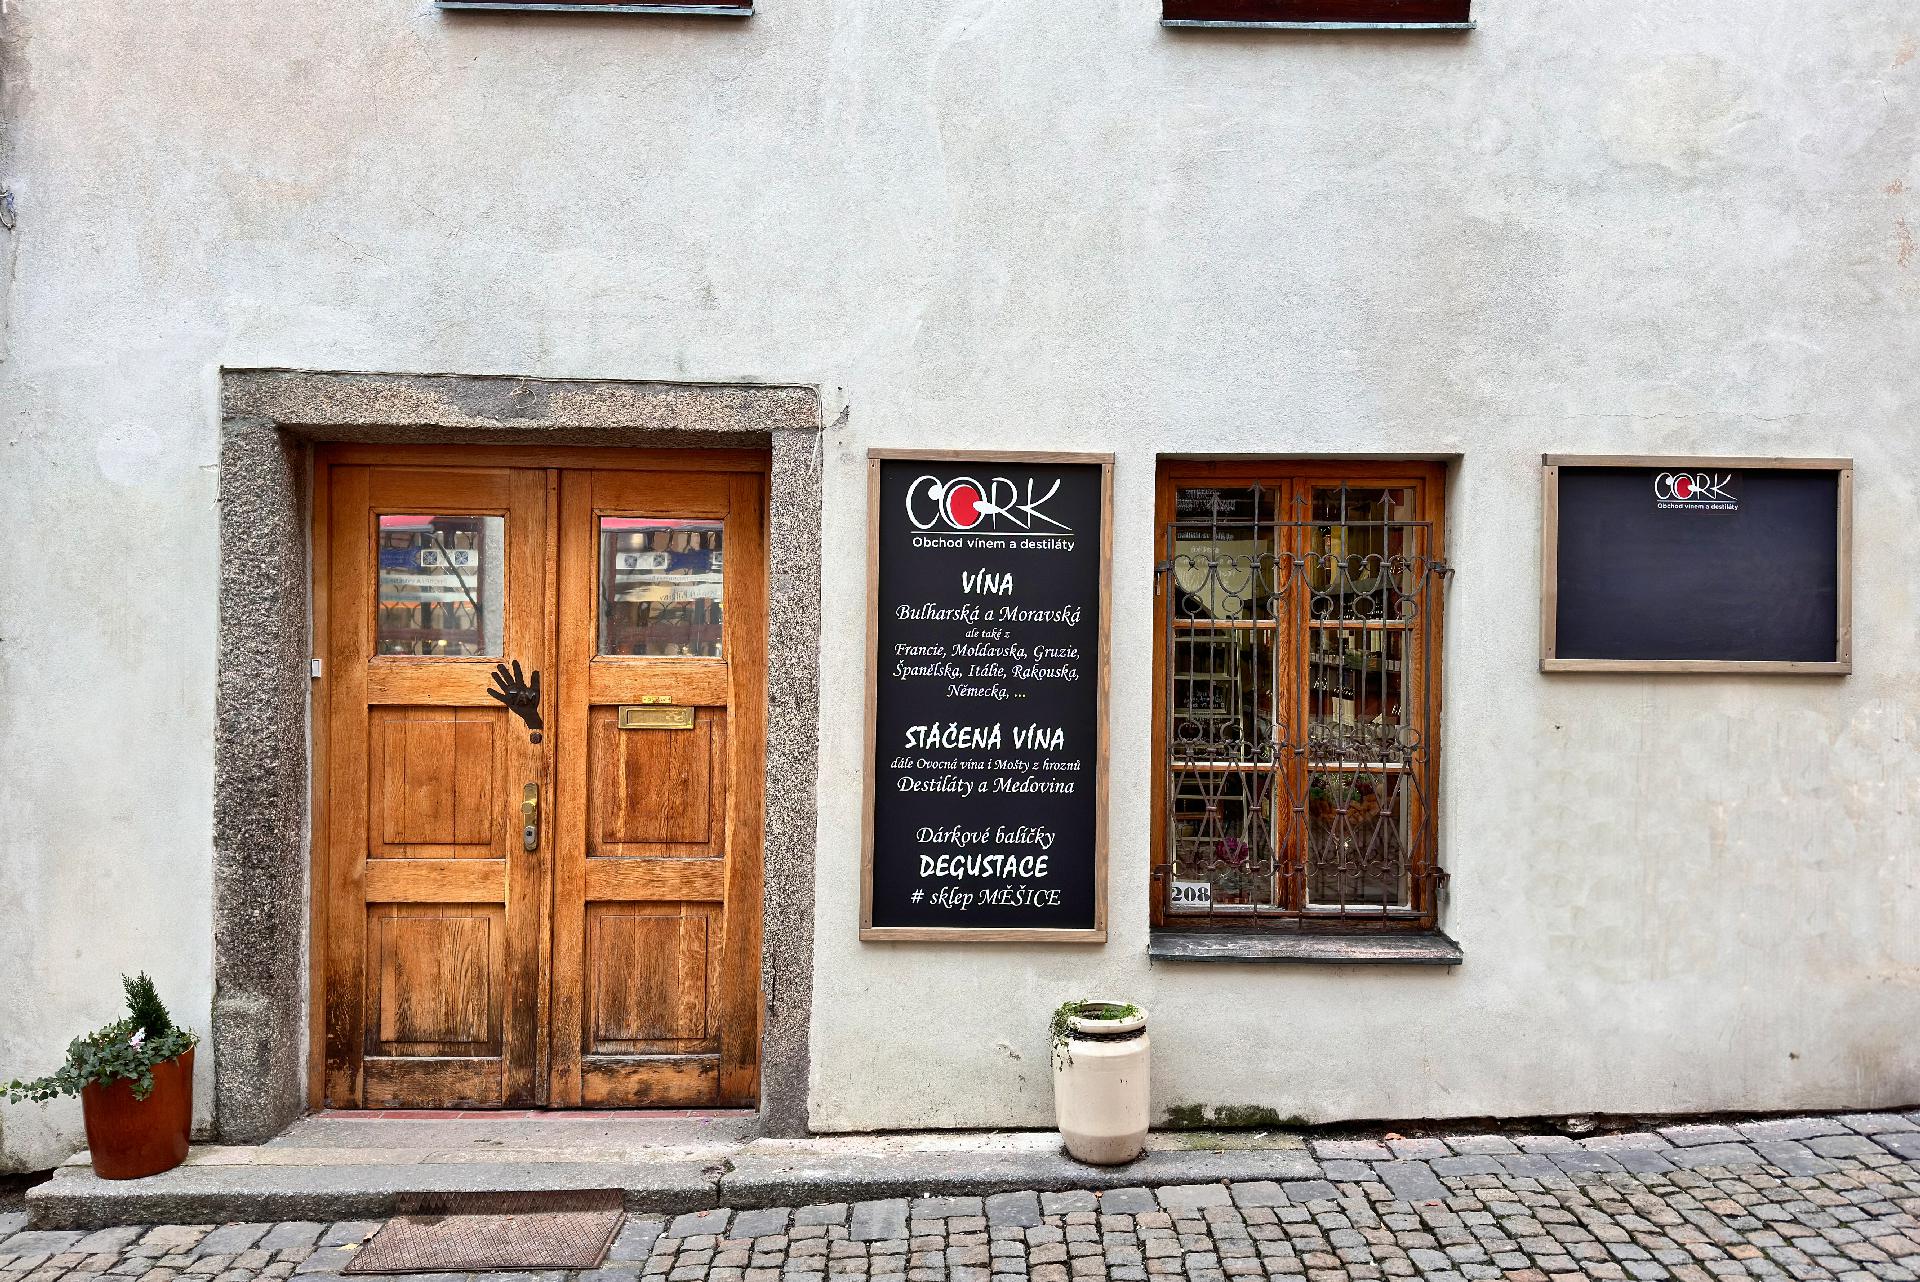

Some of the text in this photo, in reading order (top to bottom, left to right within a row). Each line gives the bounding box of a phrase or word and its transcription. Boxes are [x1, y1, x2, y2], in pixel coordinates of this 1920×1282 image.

[1655, 473, 1737, 502] CORK
[906, 475, 1072, 532] CORK
[1658, 501, 1685, 509] Obchod
[913, 537, 1074, 551] Obchod vínem a destiláty
[962, 568, 1013, 595] VÍNA
[896, 603, 1080, 626] Bulharská a Moravská
[966, 628, 979, 638] ale
[982, 628, 1002, 640] také
[895, 643, 1079, 662] Francie, Moldavska, Gruzie,
[893, 660, 1079, 681] Španělska, Itálie, Rakouska,
[947, 683, 1009, 700] Německa,
[905, 722, 1064, 751] STÁČENÁ VÍNA
[891, 757, 913, 768] dále
[917, 758, 957, 769] Ovocná
[960, 759, 984, 769] vína
[994, 760, 1029, 773] Mošty
[1032, 762, 1039, 770] z
[1043, 758, 1080, 770] hroznů
[897, 775, 1074, 797] Destiláty a Medovina
[917, 825, 1055, 849] Dárkové balíčky
[920, 854, 1048, 880] DEGUSTACE
[911, 885, 1060, 910] # sklep MĚŠICE
[1171, 886, 1211, 902] 208
